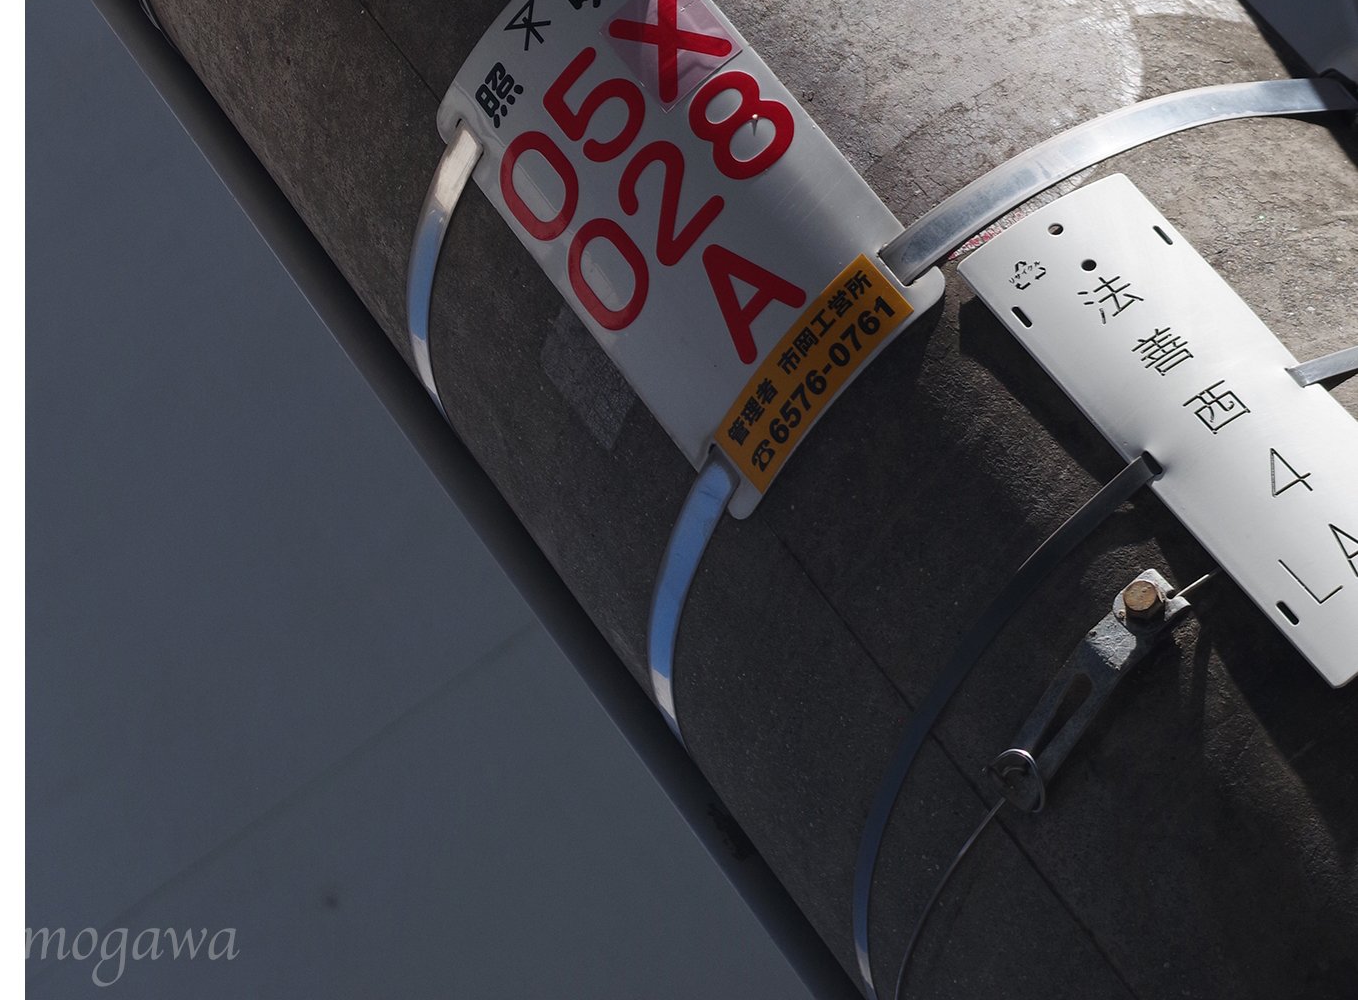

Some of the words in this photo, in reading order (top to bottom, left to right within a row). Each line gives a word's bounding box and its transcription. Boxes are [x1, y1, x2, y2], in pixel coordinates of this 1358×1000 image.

[567, 70, 795, 331] 028
[703, 244, 807, 365] A
[728, 378, 778, 446] 管理者
[777, 270, 872, 375] 市岡工営所
[769, 296, 895, 444] 6576-0761
[1077, 274, 1250, 435] 法善西
[1270, 447, 1313, 499] 4
